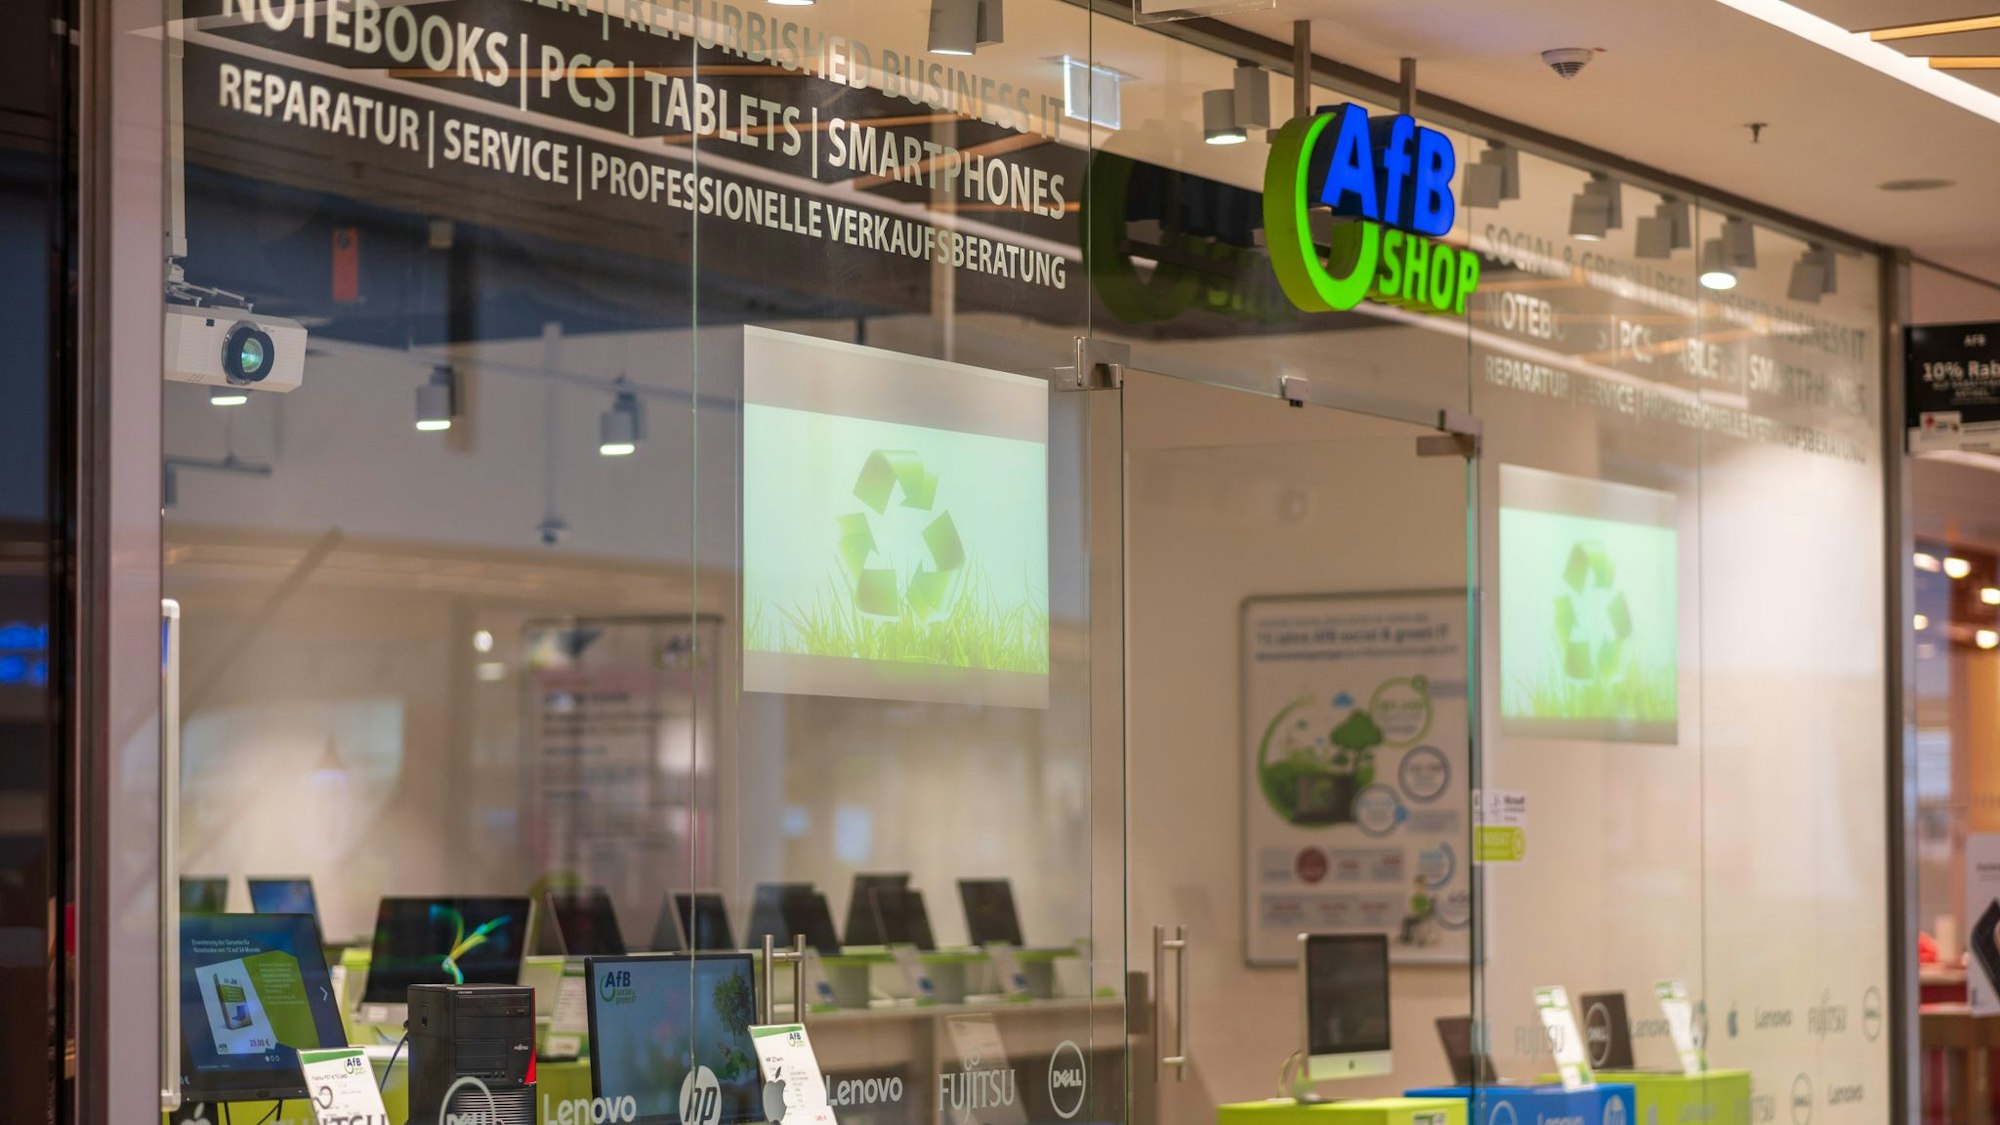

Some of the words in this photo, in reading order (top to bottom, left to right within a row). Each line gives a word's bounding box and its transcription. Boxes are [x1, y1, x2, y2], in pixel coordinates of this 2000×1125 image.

[882, 49, 1031, 134] BUSINESS
[1041, 93, 1065, 143] IT
[541, 45, 616, 112] PCS
[644, 71, 801, 157] TABLETS
[828, 118, 1065, 220] SMARTPHONES
[219, 63, 420, 151] REPARATUR
[443, 118, 569, 184] SERVICE
[591, 152, 822, 238] PROFESSIONELLE
[826, 204, 1066, 290] VERKAUFSBERATUNG
[1320, 102, 1456, 237] AfB
[1379, 229, 1481, 315] SHOP
[1485, 355, 1570, 398] REPARATUR
[1922, 361, 1964, 382] 10%
[605, 970, 631, 988] AfB
[346, 1057, 362, 1067] AfB
[1052, 1068, 1082, 1088] DELL
[543, 1093, 637, 1125] Lenovo
[826, 1075, 903, 1106] Lenovo
[938, 1068, 1016, 1123] FUJITSU
